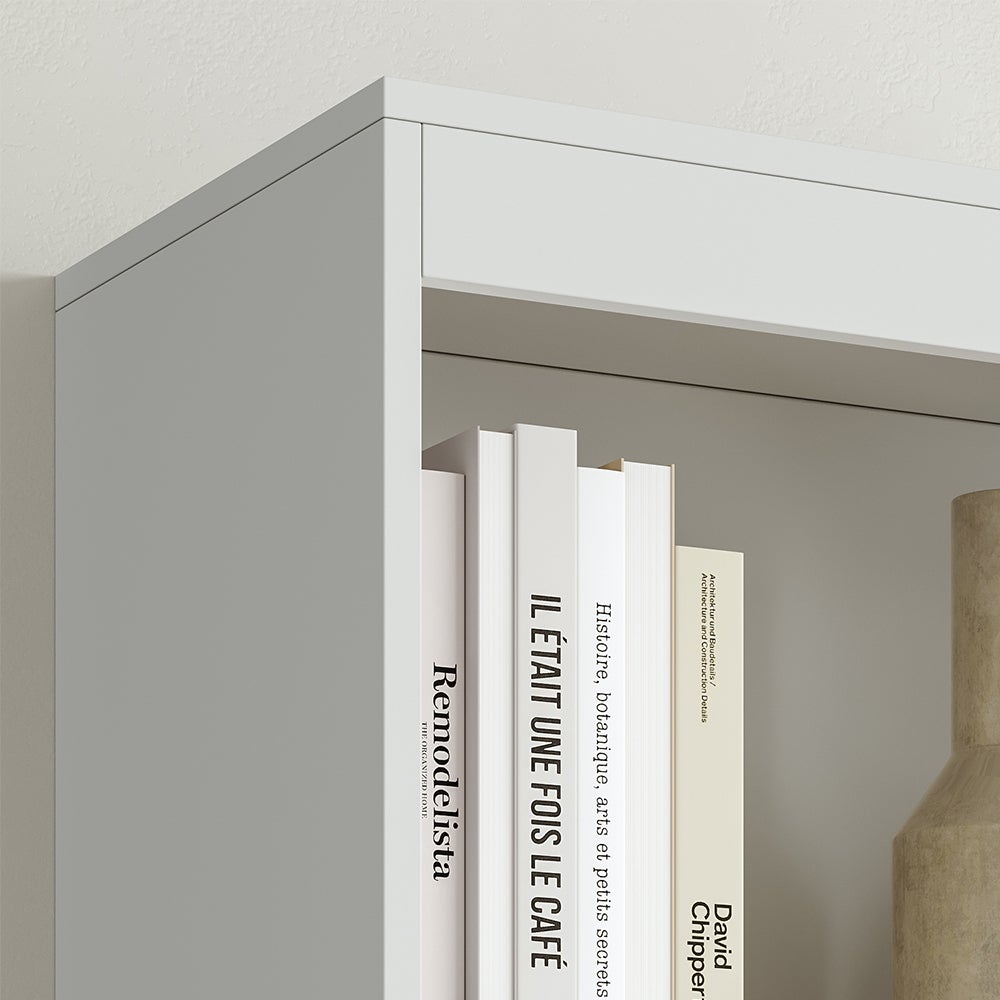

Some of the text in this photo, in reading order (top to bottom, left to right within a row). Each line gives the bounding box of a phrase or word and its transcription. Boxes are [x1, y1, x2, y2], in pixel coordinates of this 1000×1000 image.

[433, 663, 459, 881] Remodelista
[701, 642, 709, 693] Construction
[531, 595, 567, 969] IL ÉTAIT UNE FOIS LE CAFÉ
[593, 603, 611, 997] Histoire, botanique, arts et petits secrets
[714, 904, 732, 969] David
